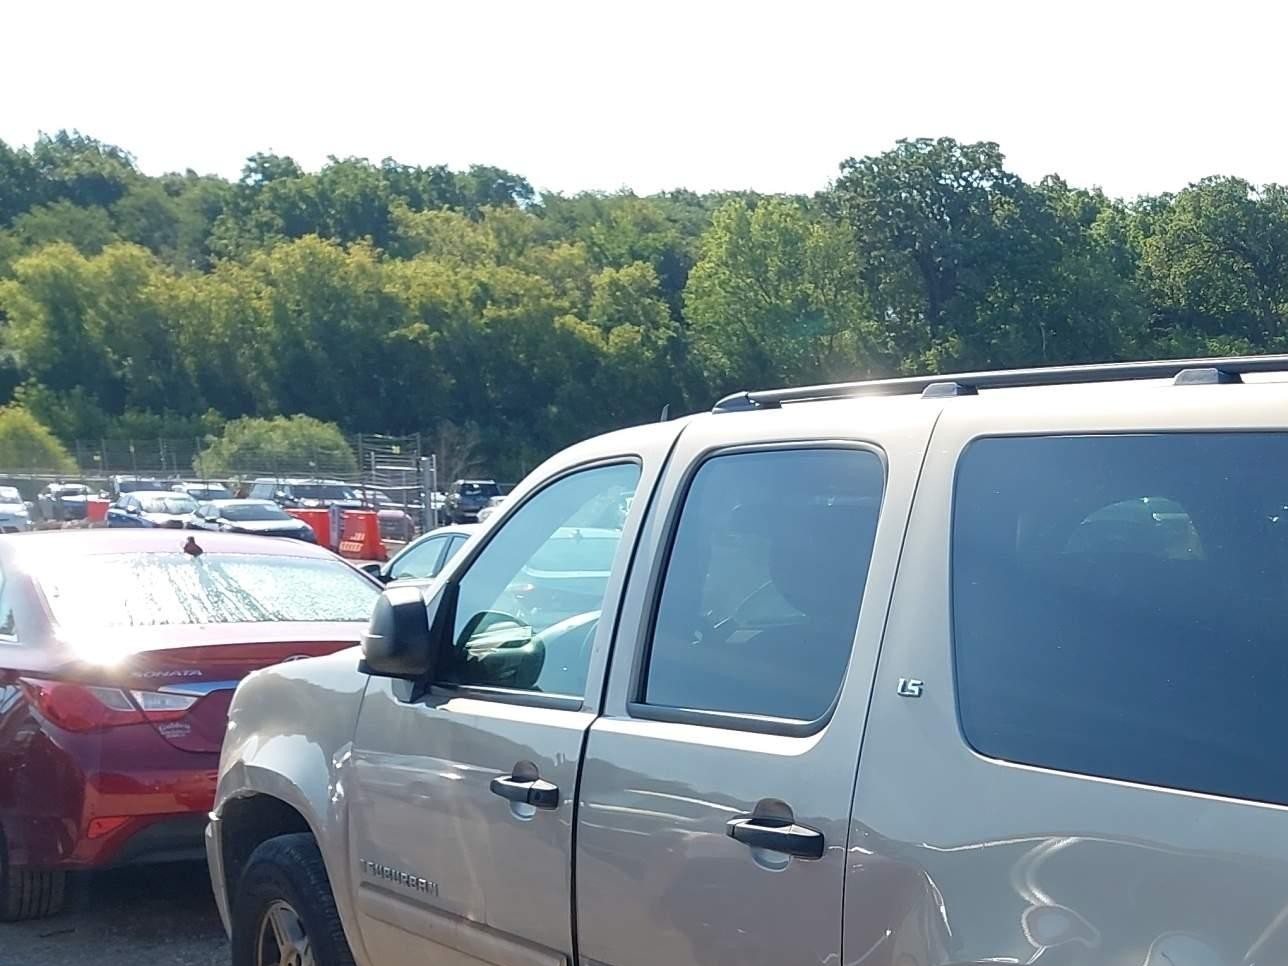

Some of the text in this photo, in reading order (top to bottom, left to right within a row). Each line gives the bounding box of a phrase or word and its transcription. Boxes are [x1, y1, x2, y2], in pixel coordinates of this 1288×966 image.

[131, 669, 203, 679] SONATA
[896, 677, 924, 698] LS
[360, 858, 439, 897] SUBURBAN
